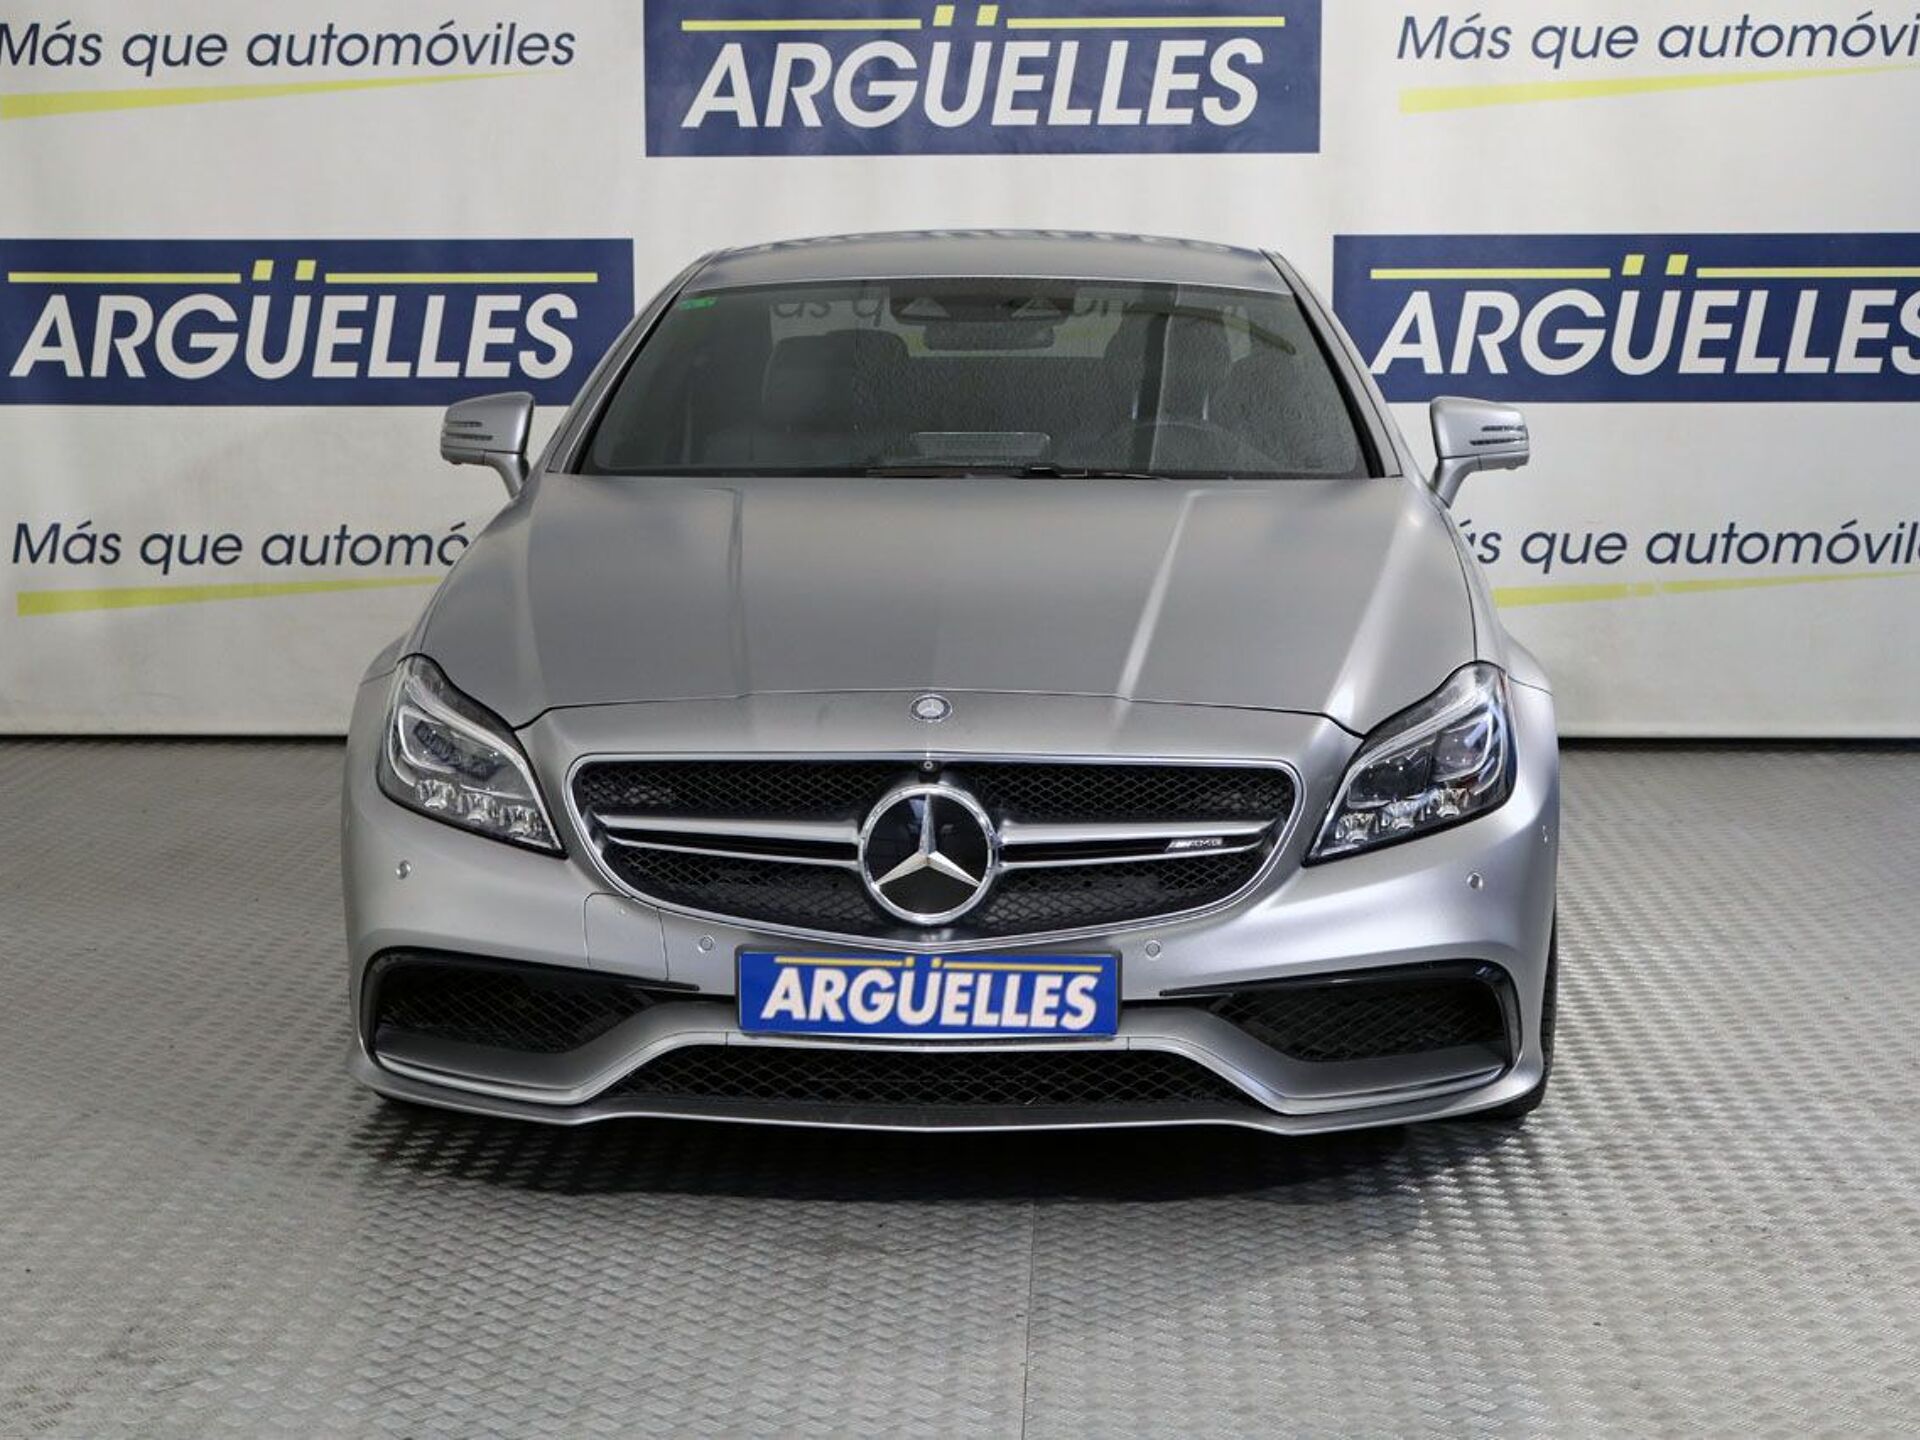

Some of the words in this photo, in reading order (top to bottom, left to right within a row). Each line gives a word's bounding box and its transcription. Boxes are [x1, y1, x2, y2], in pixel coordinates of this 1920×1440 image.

[0, 19, 103, 66] Más
[121, 33, 228, 77] que
[246, 19, 576, 67] automóviles
[680, 4, 1264, 128] ARGÜELLES
[1397, 13, 1512, 60] Más
[1531, 25, 1639, 70] que
[1658, 10, 1920, 59] automóvi
[9, 259, 578, 379] ARGÜELLES
[11, 519, 122, 566] Más
[139, 532, 244, 577] que
[260, 520, 470, 567] automó
[1520, 531, 1628, 575] que
[1645, 519, 1920, 565] automóvil
[760, 956, 1098, 1030] ARGÜELLES
